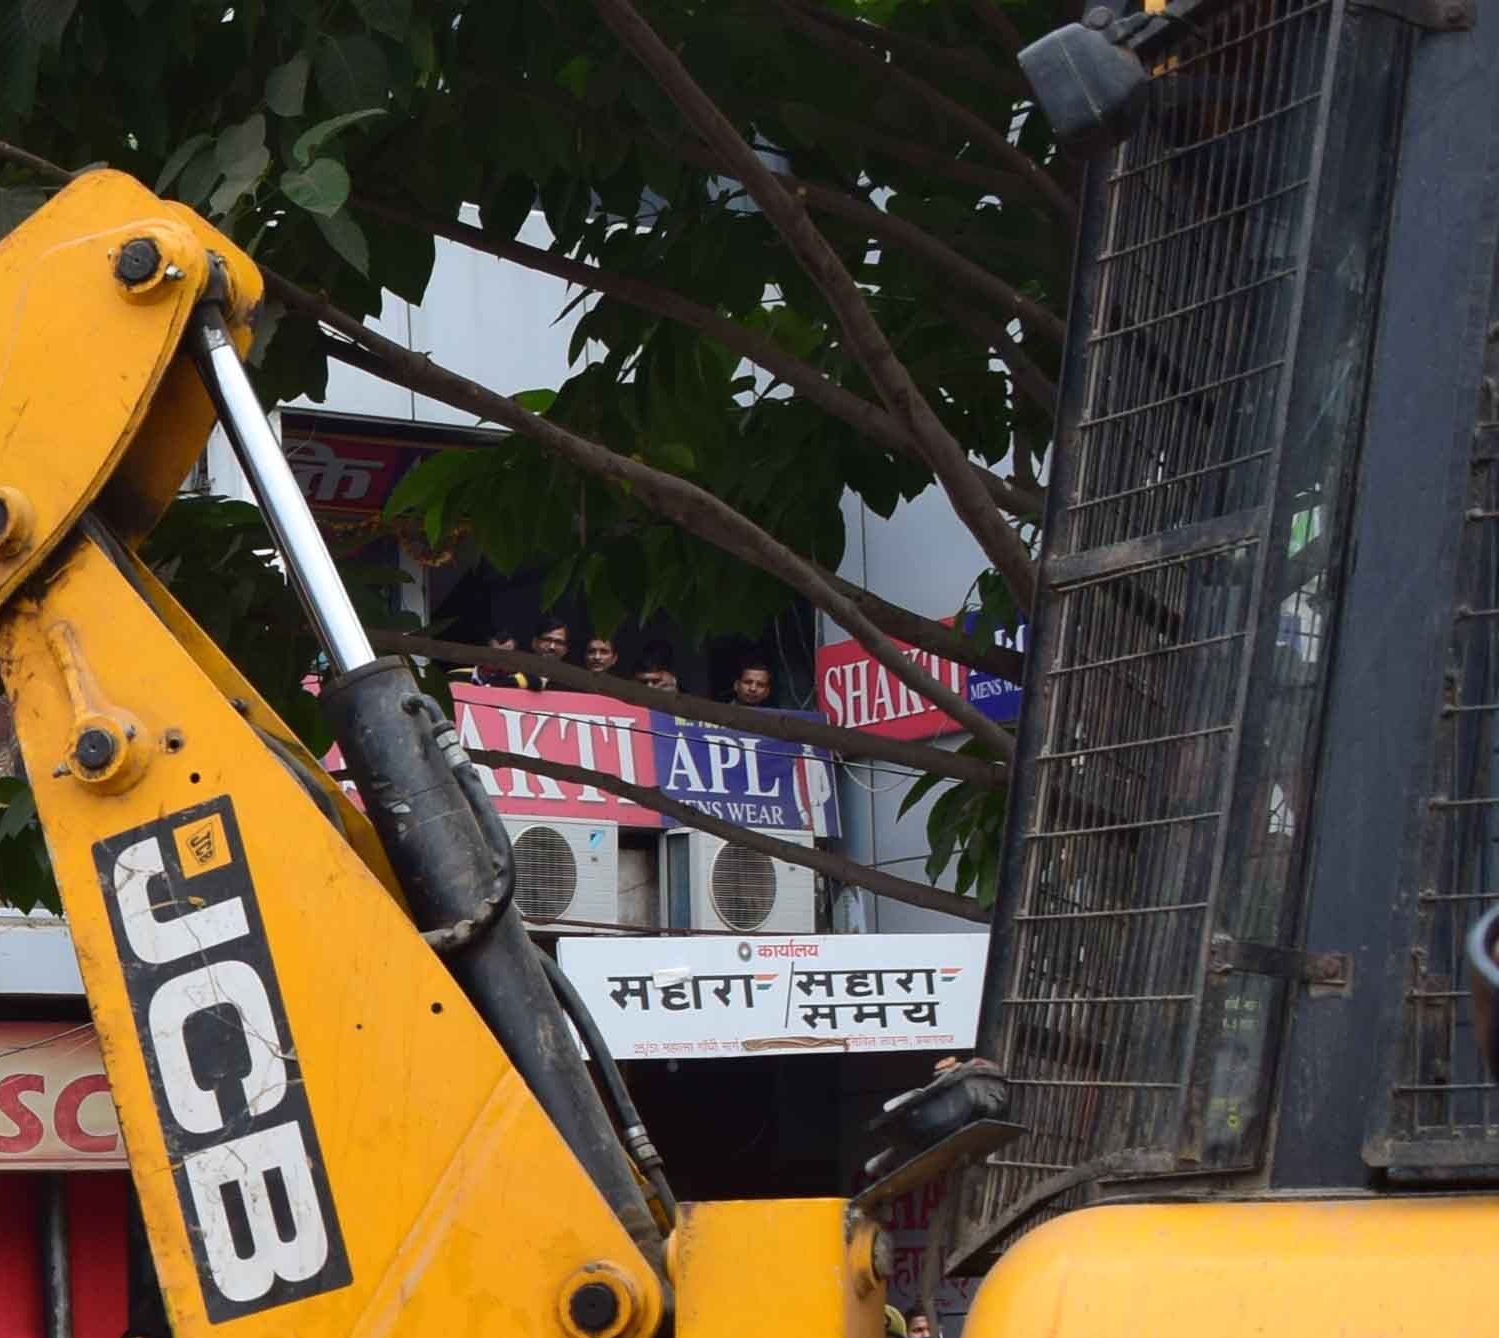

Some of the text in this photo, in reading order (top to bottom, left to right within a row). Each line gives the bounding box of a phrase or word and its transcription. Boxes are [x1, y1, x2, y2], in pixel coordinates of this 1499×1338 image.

[451, 703, 636, 805] AKTI
[666, 732, 780, 798] APL
[725, 801, 785, 825] WEAR
[757, 939, 819, 959] कार्यालय
[608, 972, 755, 1011] सहारा
[794, 967, 937, 998] सहारा
[799, 1000, 940, 1030] समय
[113, 836, 329, 1302] JCB
